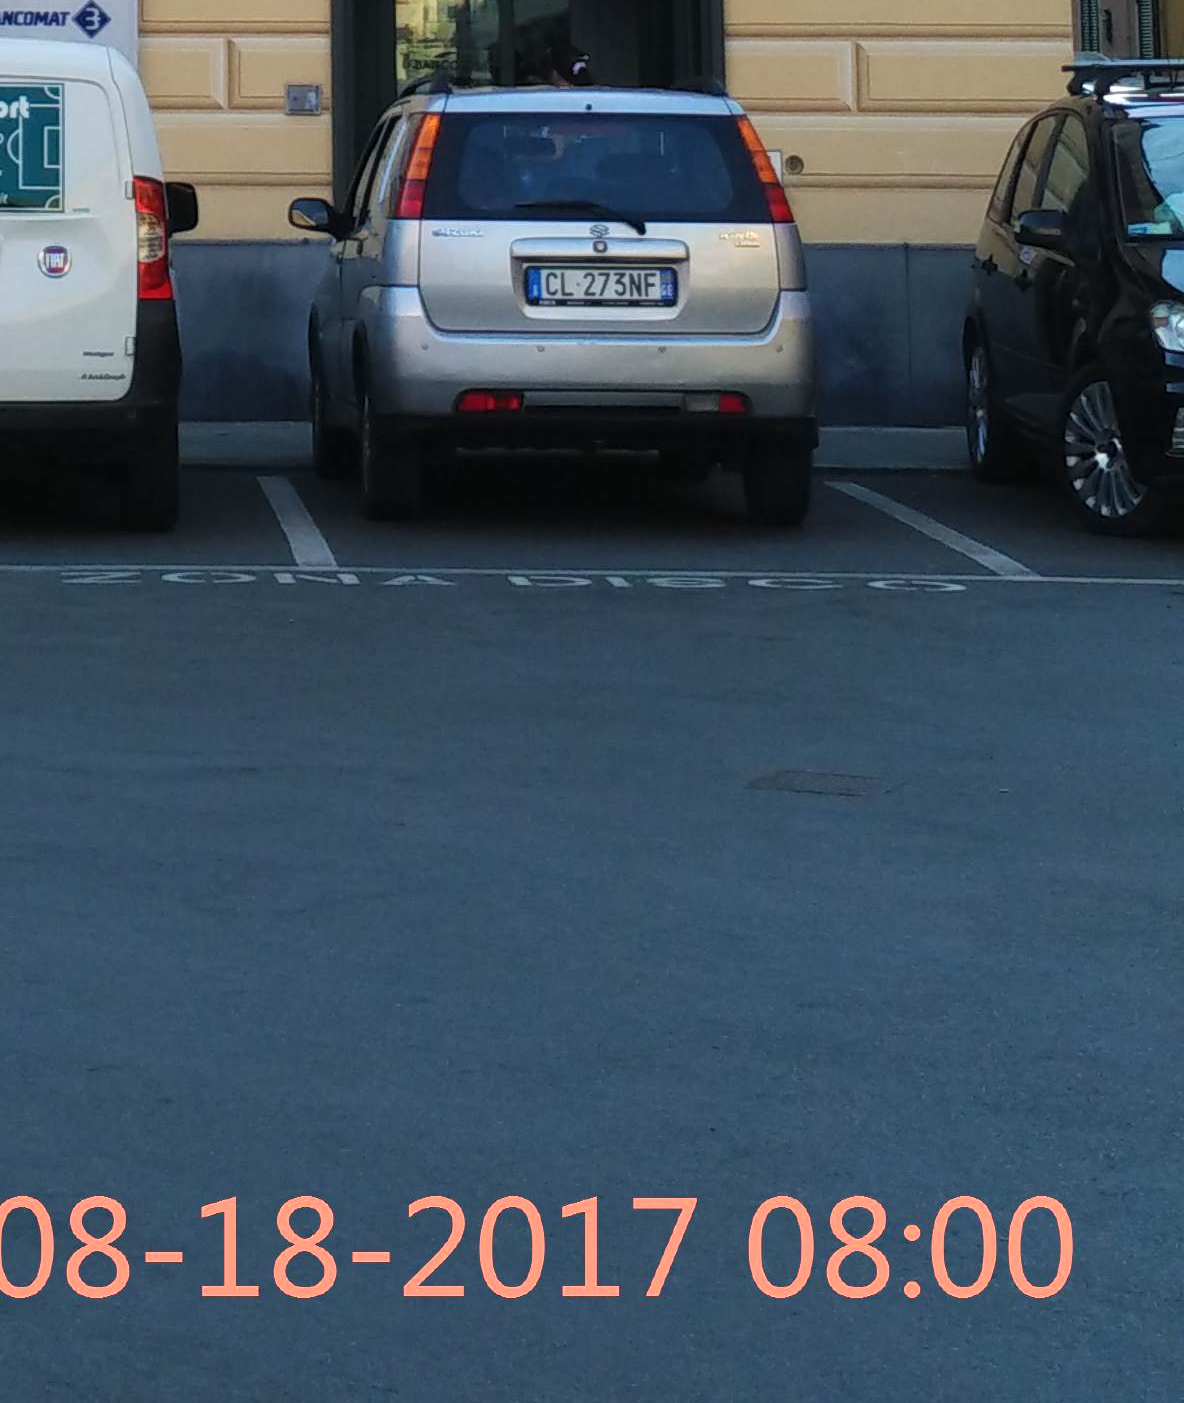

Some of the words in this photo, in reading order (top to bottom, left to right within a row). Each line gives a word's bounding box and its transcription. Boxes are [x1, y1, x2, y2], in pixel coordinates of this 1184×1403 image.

[545, 271, 574, 297] CL
[583, 271, 657, 297] 273NF
[59, 570, 457, 586] ZONA
[506, 574, 968, 592] DISCO
